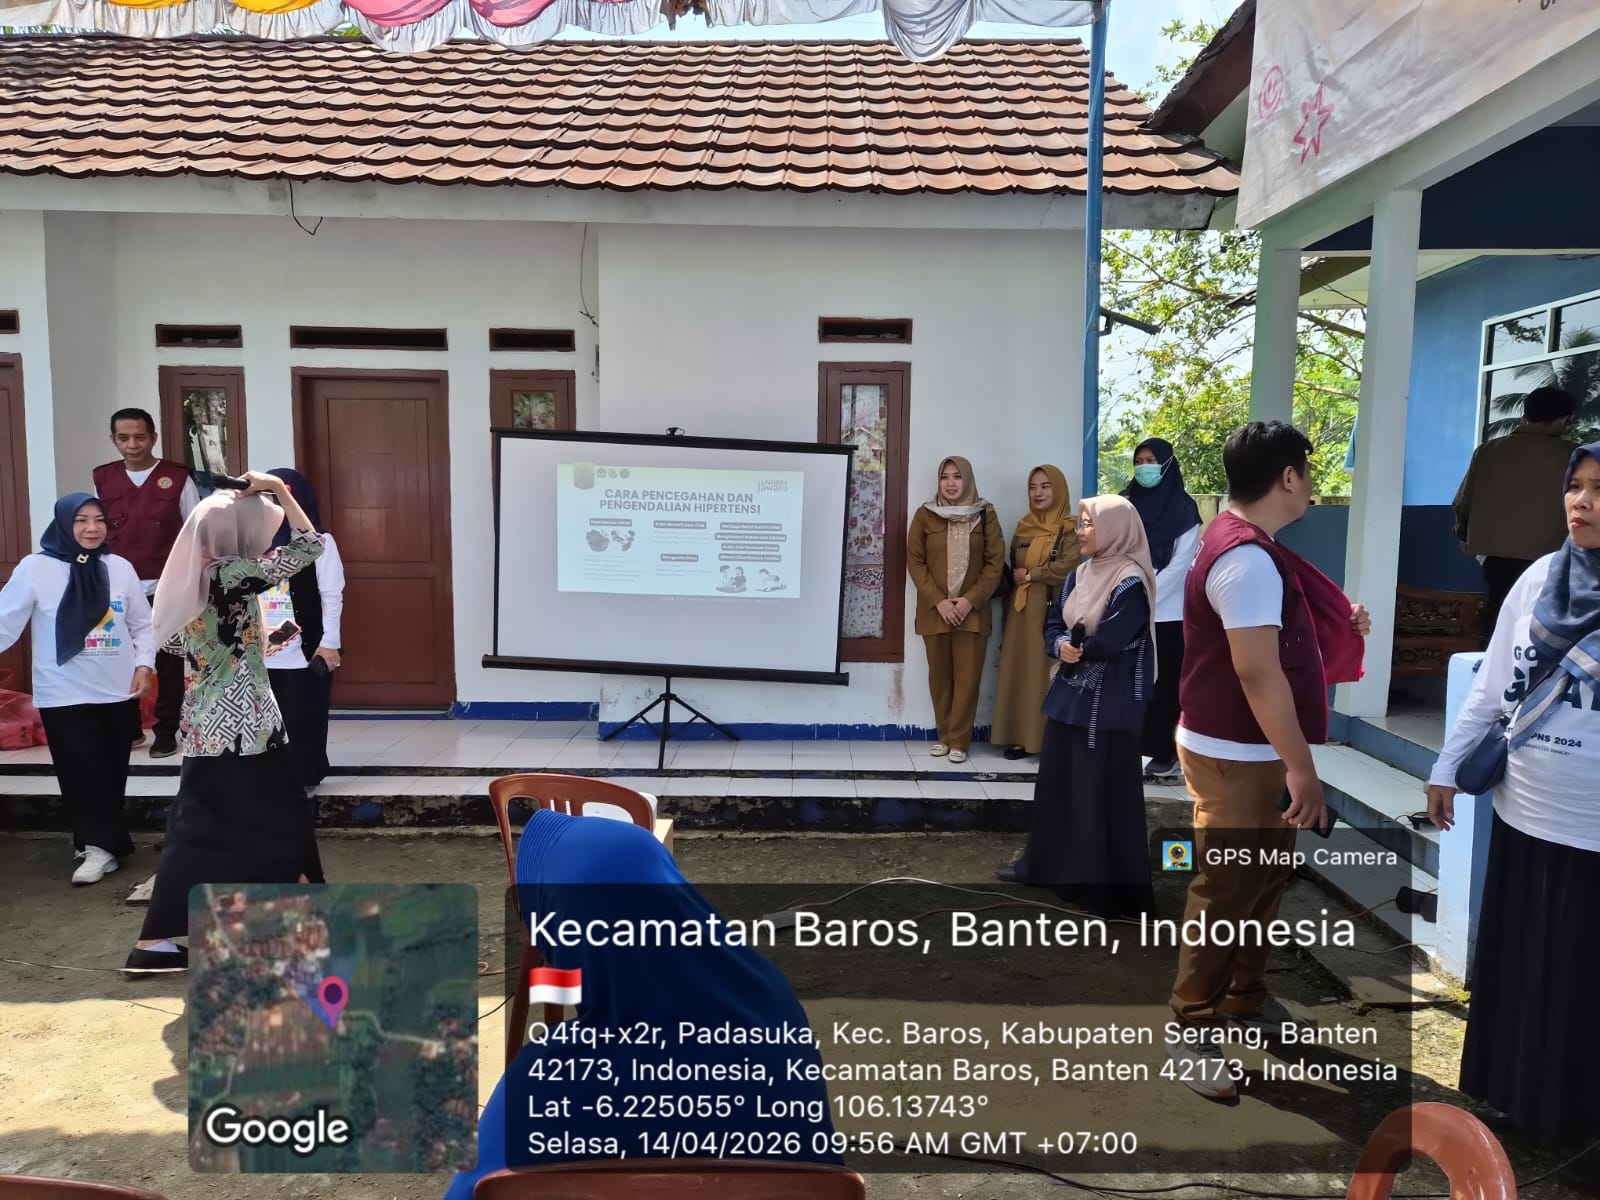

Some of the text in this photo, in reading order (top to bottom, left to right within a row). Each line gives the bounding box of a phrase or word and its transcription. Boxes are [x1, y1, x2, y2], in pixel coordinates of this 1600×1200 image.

[604, 488, 754, 503] CARA PENCEGAHAN DAN
[599, 499, 761, 515] PENGENDALIAN HIPERTENSI
[1530, 732, 1582, 748] PNS 2024
